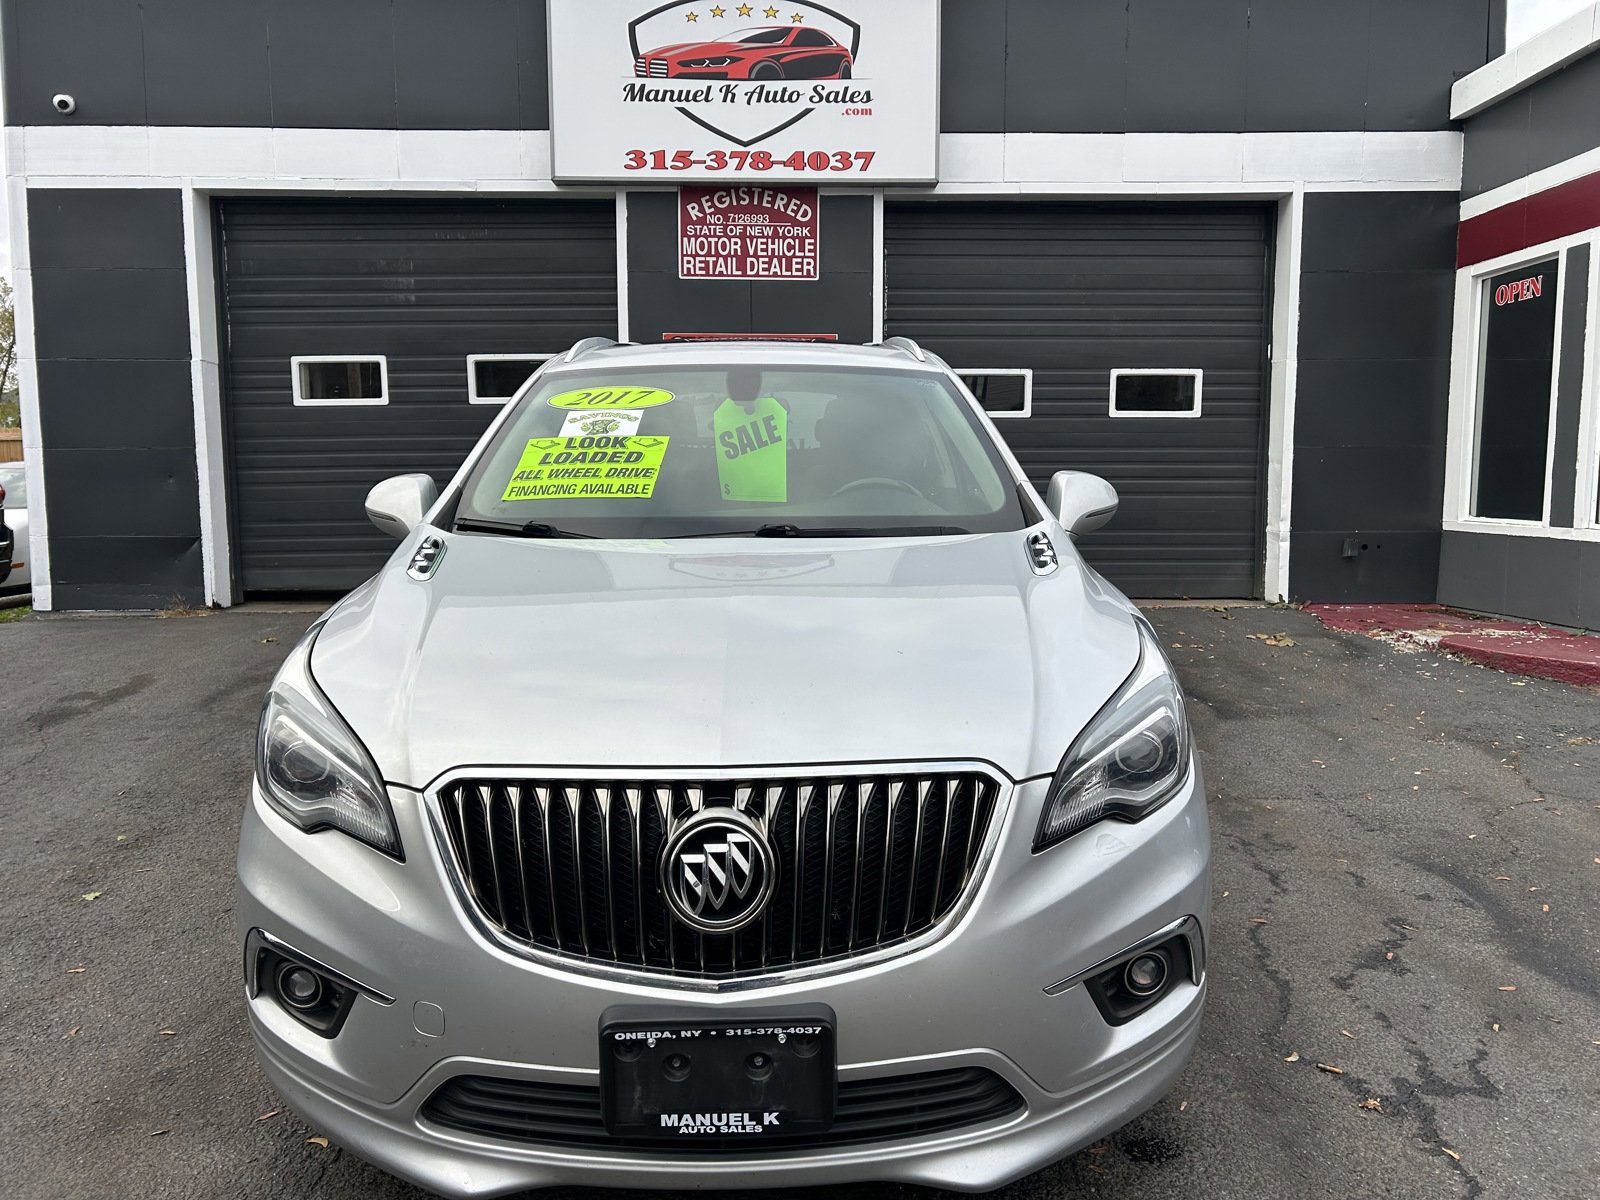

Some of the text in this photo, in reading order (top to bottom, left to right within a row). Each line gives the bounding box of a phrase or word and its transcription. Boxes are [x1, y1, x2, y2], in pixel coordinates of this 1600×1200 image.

[623, 83, 874, 106] Manuel K Auto Sales
[841, 108, 872, 116] .com
[623, 149, 876, 172] 315-378-4037
[686, 187, 812, 222] REGISTERED
[706, 213, 770, 224] NO. 7126993
[686, 225, 811, 237] STATE OF NEW YORK
[683, 237, 815, 257] MOTOR VEHICLE
[683, 257, 815, 276] RETAIL DEALER
[1495, 275, 1543, 306] OPEN
[565, 390, 656, 406] 2017
[567, 412, 640, 424] SAVINGS
[564, 436, 632, 450] LOOK
[719, 414, 782, 460] SALE
[538, 451, 646, 466] LOADED
[512, 467, 657, 482] ALL WHEEL DRIVE
[508, 483, 651, 497] FINANCING AVAILABLE
[724, 483, 731, 495] $
[614, 1026, 822, 1040] ONEIDA, NY 315-378-4037
[660, 1112, 780, 1127] MANUEL K
[679, 1124, 763, 1134] AUTO SALES
